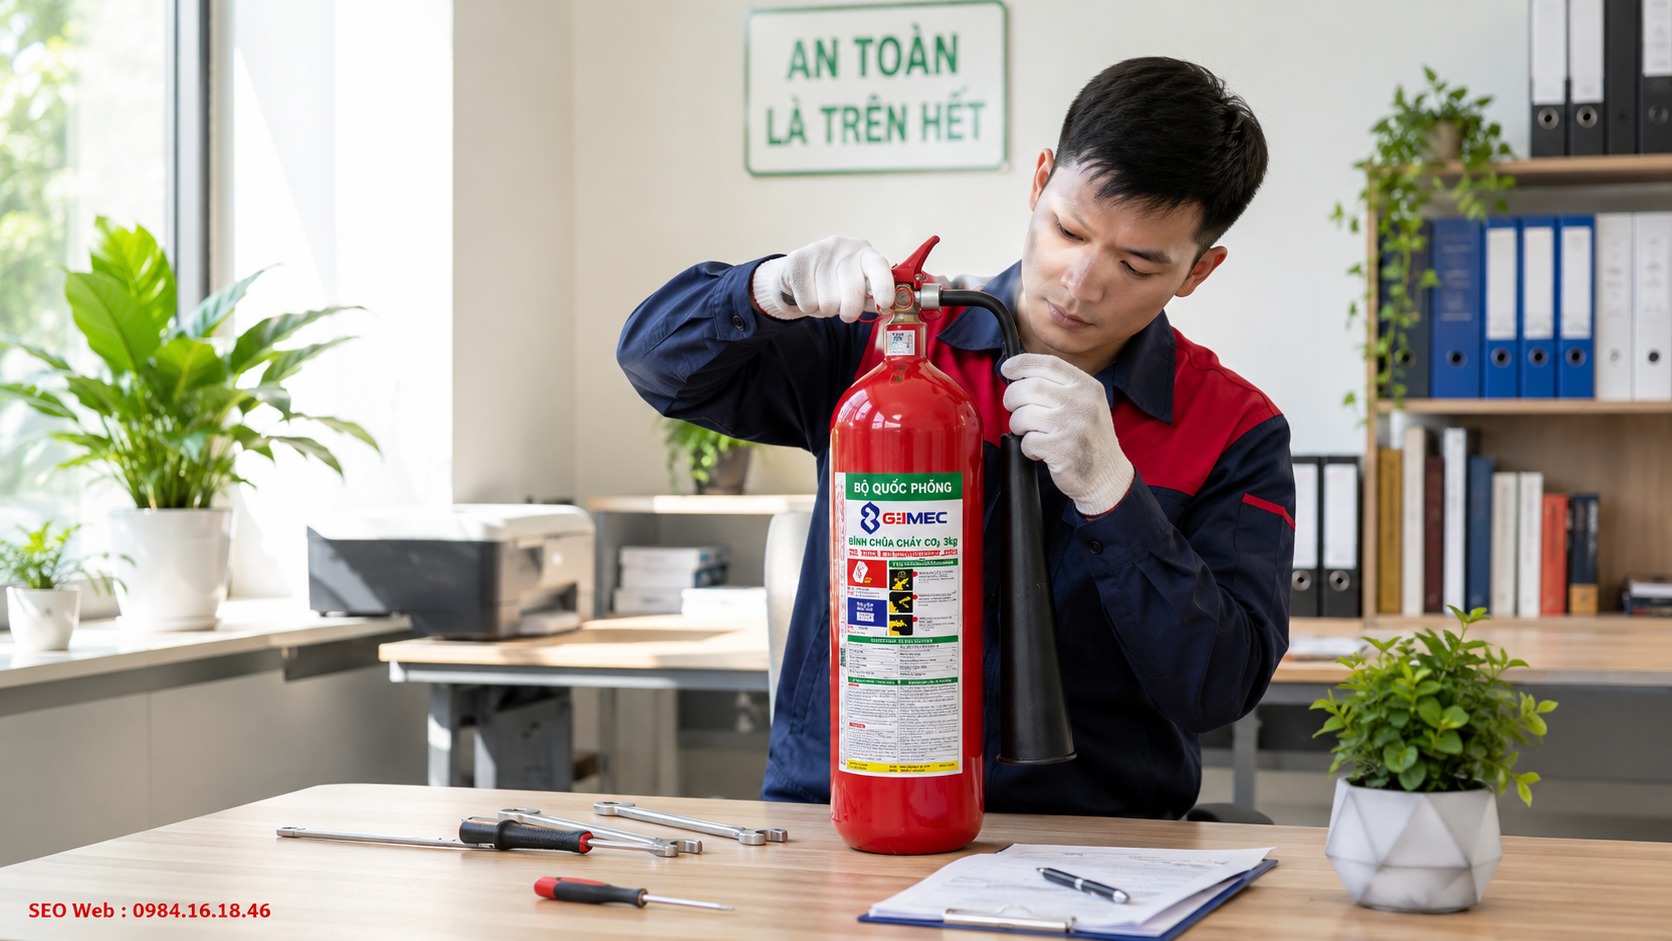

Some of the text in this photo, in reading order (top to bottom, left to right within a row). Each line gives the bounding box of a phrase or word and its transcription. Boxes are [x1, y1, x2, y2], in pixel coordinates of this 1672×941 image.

[787, 22, 959, 81] AN TOÀN
[766, 85, 986, 146] LÀ TRÊN HẾT
[853, 479, 869, 497] BỘ
[872, 478, 907, 496] QUỐC
